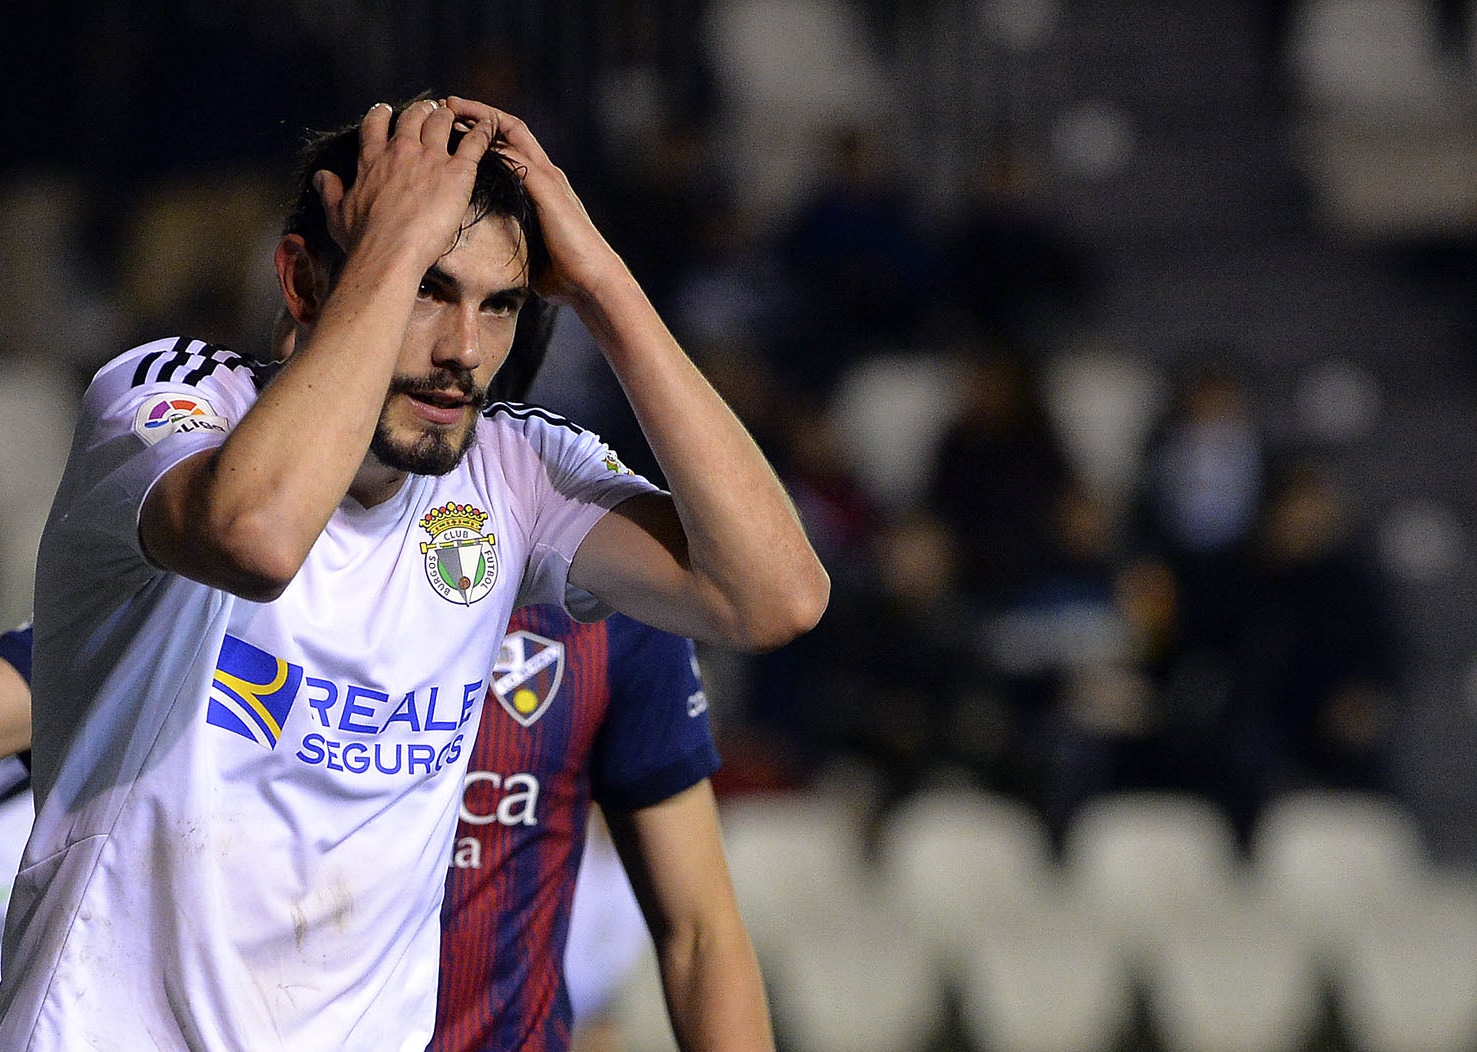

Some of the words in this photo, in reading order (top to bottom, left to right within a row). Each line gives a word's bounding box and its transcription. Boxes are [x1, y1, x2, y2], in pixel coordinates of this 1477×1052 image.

[443, 530, 469, 541] CLUB
[428, 555, 451, 596] BURGOS
[480, 549, 495, 590] FUTBOL
[305, 676, 483, 735] REALE
